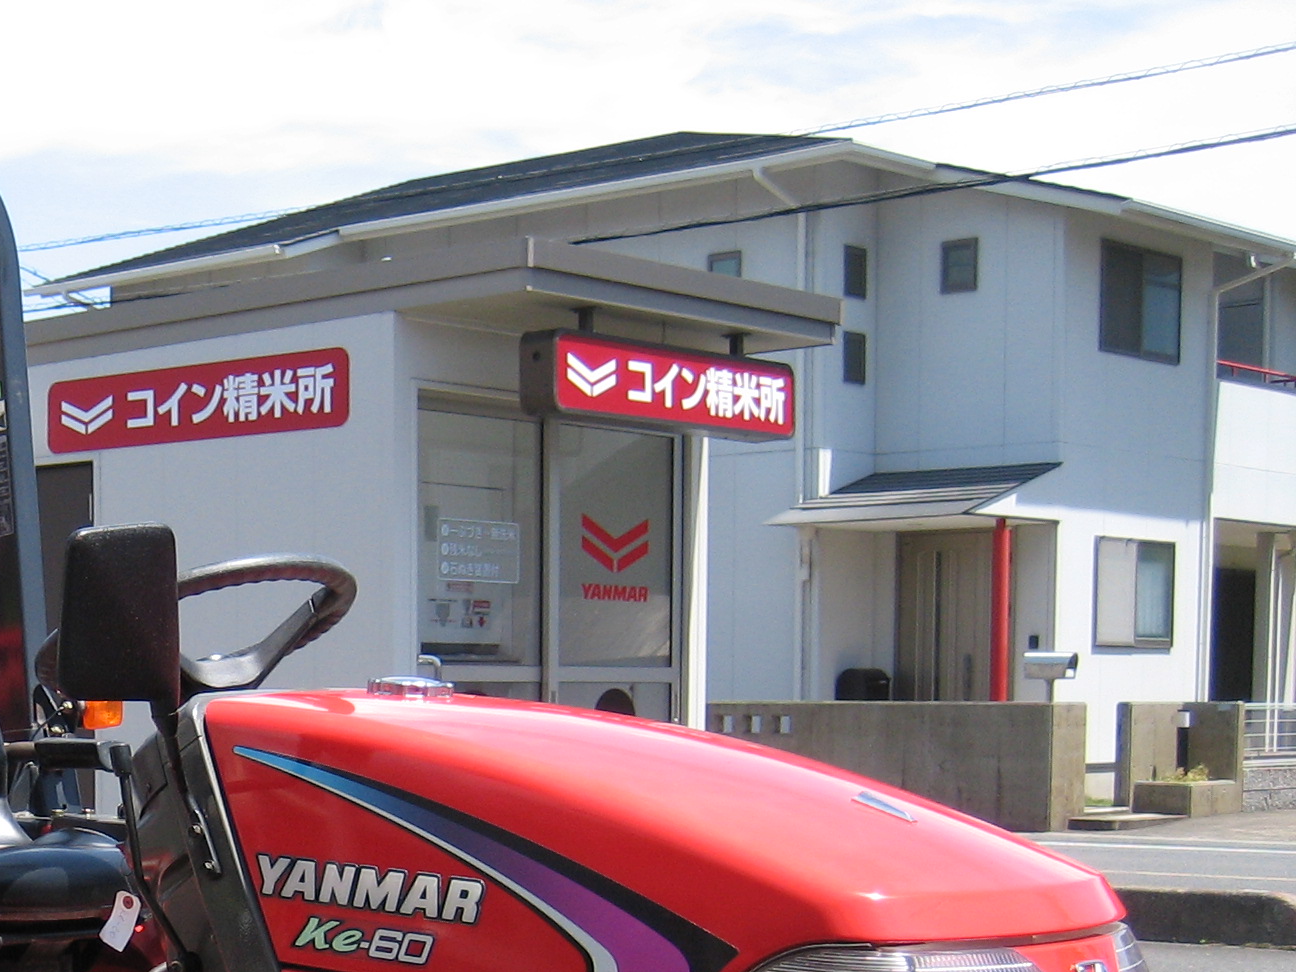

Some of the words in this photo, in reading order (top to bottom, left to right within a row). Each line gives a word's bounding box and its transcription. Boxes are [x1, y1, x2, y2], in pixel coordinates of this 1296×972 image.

[126, 363, 335, 429] コイン精米所
[627, 360, 786, 425] コイン精米所
[581, 583, 649, 603] YANMAR
[256, 853, 485, 924] YANMAR
[294, 916, 435, 965] Ke-60
